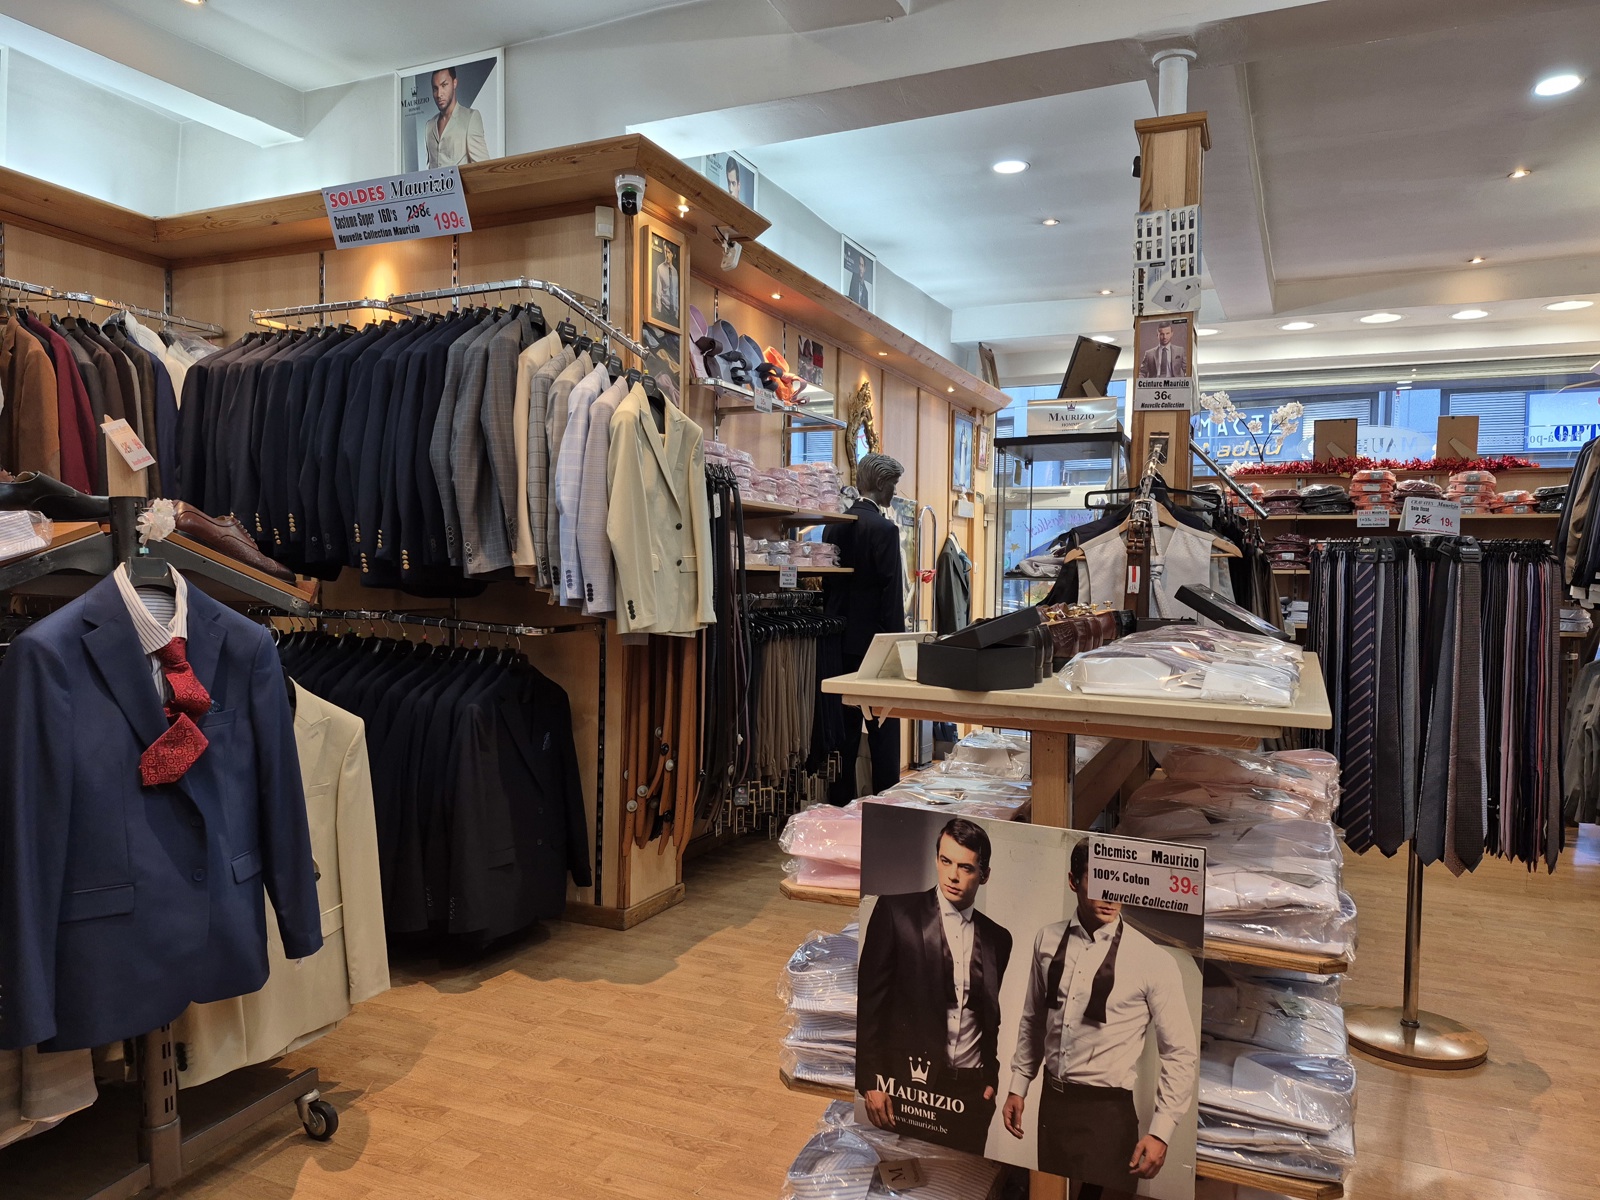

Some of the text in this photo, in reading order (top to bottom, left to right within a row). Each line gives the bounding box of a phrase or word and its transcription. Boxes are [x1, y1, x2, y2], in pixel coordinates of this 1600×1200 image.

[329, 173, 454, 208] SOLDES Maurizio
[333, 214, 358, 230] Costume
[358, 212, 374, 228] Super
[378, 208, 398, 223] 160's
[434, 210, 466, 230] 199€
[338, 224, 420, 243] Nouvelle Collection Maurizio
[1163, 379, 1189, 388] Maurizio
[1154, 391, 1172, 401] 36€
[1048, 413, 1095, 422] MAURIZIO
[1415, 514, 1453, 528] 25€ 19€
[1151, 849, 1199, 868] Maurizio
[1093, 867, 1199, 895] 100% Coton 39€
[1101, 889, 1189, 911] Nouvelle Collection
[875, 1073, 965, 1114] MAURIZIO
[901, 1103, 937, 1120] HOMME
[889, 1114, 948, 1134] www.maurizio.be
